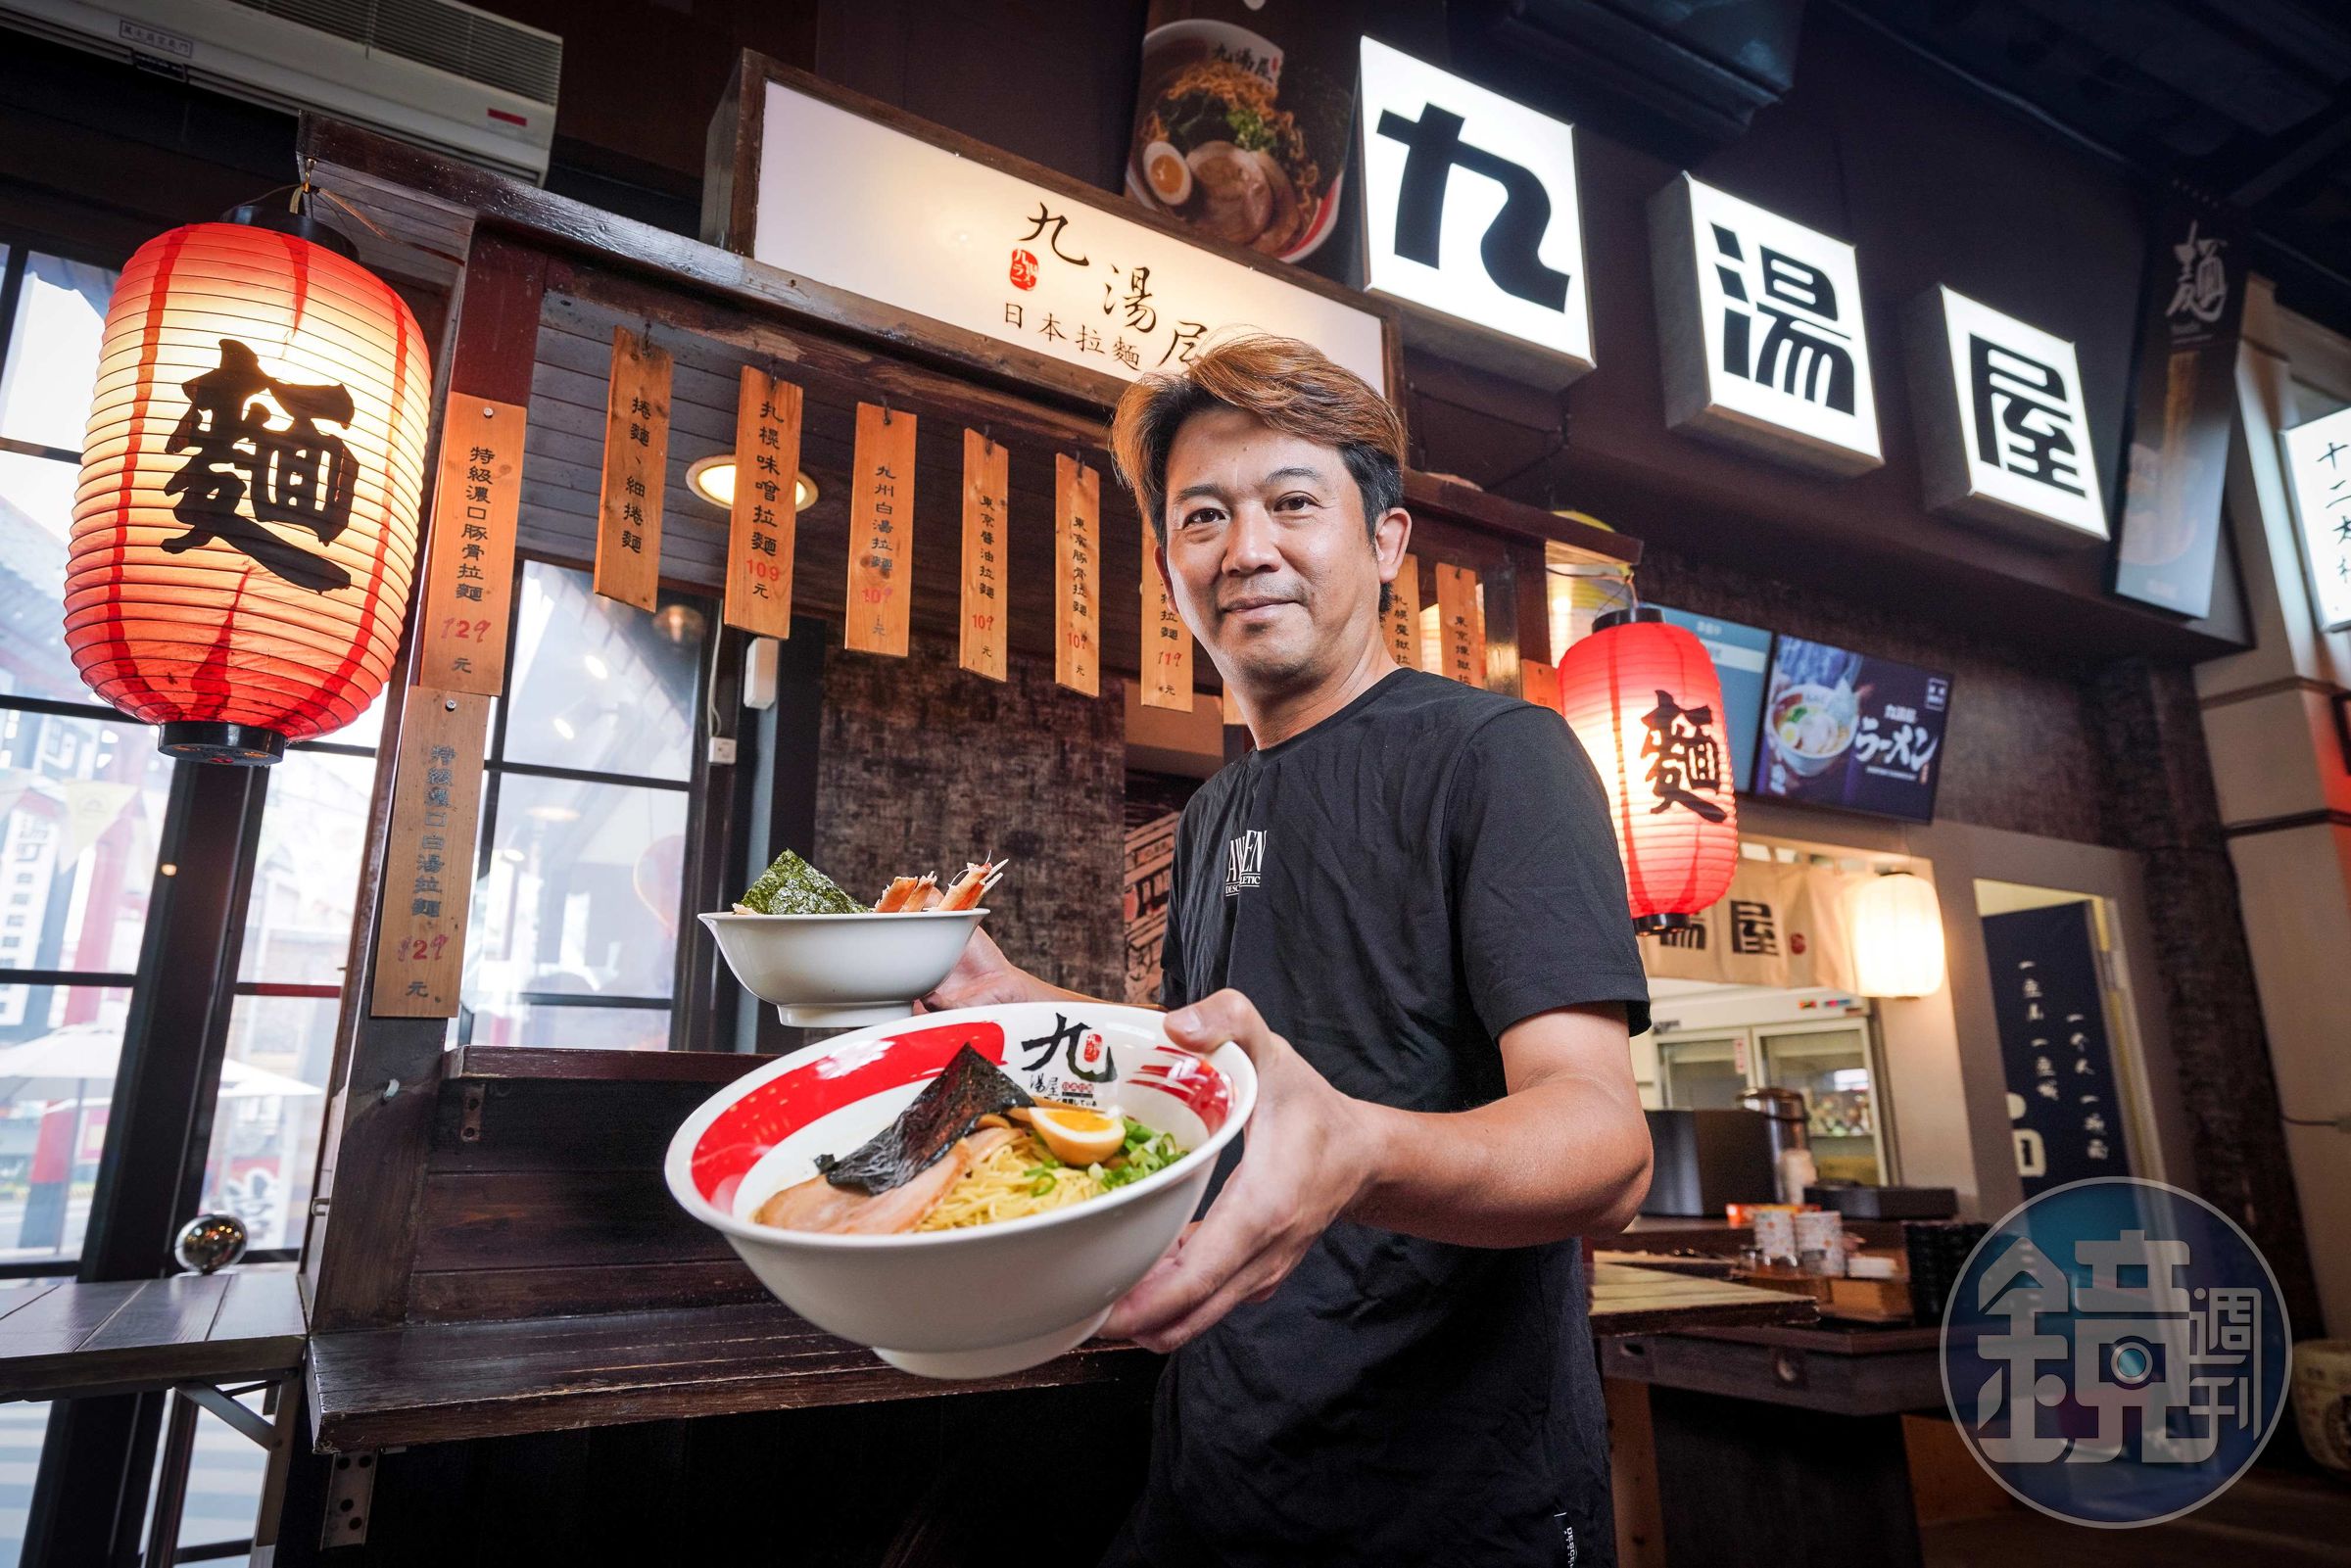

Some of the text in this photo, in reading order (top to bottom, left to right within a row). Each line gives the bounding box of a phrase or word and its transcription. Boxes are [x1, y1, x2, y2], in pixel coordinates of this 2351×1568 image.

[1005, 302, 1141, 371] 日本拉麵
[160, 338, 360, 595] 麵
[869, 465, 897, 574] 九州白湯拉麵
[441, 446, 496, 674] 特級濃口豚骨拉麵 129 元
[746, 559, 781, 582] 109
[752, 583, 769, 599] 元
[982, 644, 992, 658] 元
[1076, 664, 1085, 677] 元
[1165, 685, 1176, 696] 元
[1640, 689, 1727, 824] 麵
[405, 980, 429, 998] 元
[1021, 1012, 1118, 1083] 九
